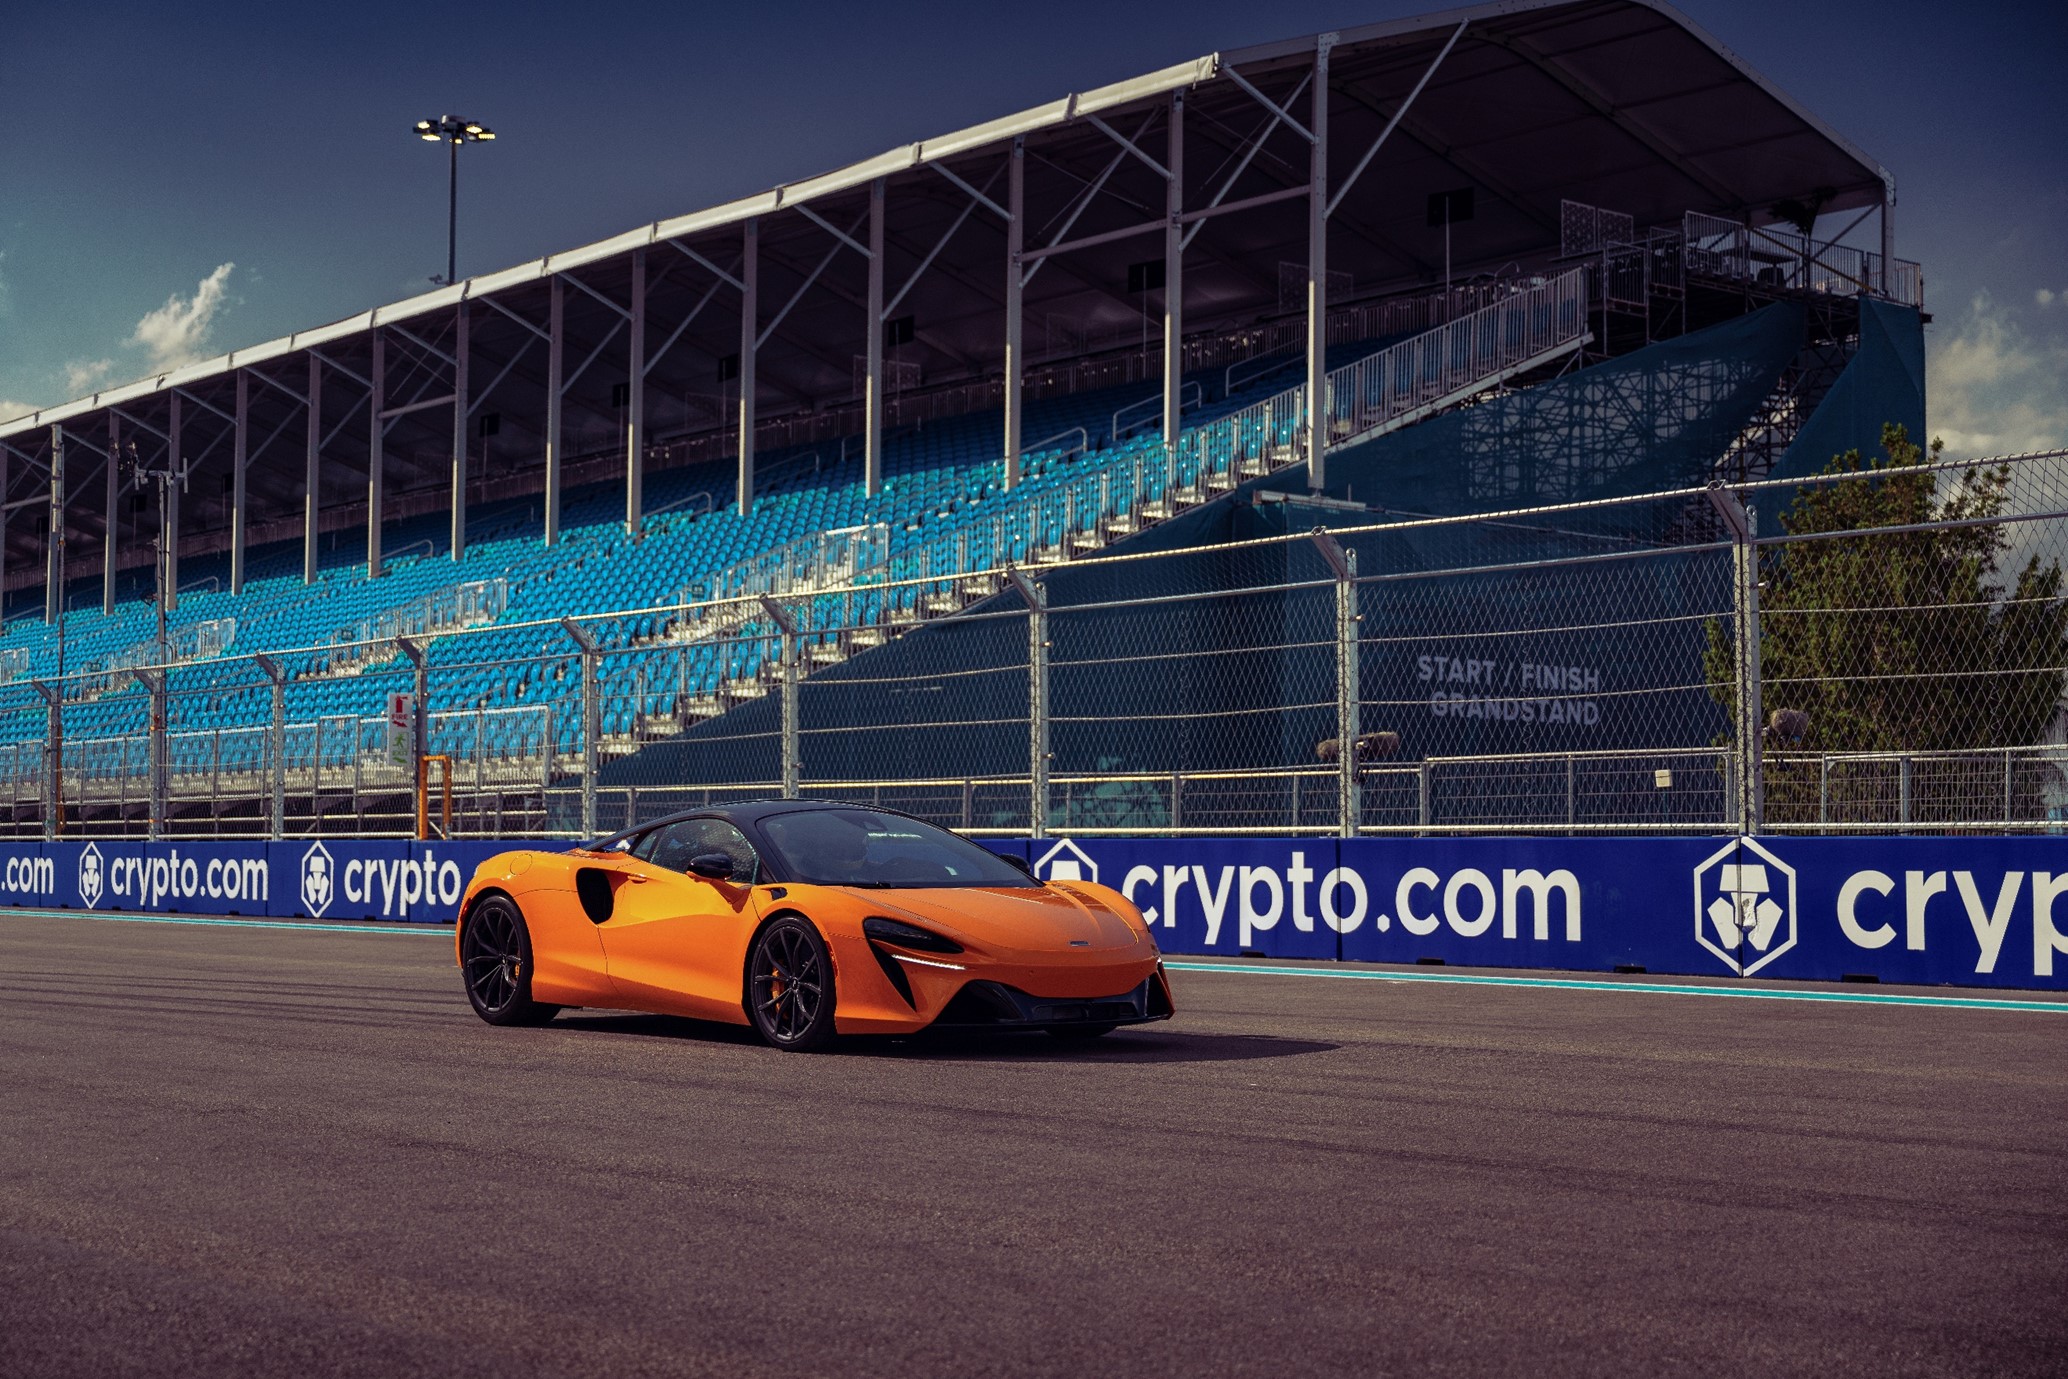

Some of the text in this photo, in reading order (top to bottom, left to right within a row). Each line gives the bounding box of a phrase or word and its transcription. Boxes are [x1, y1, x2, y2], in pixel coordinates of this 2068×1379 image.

[1417, 655, 1599, 692] START / FINISH
[1430, 691, 1599, 725] GRANDSTAND
[111, 849, 269, 907] crypto.com
[344, 849, 461, 917] crypto
[1122, 851, 1581, 947] crypto.com
